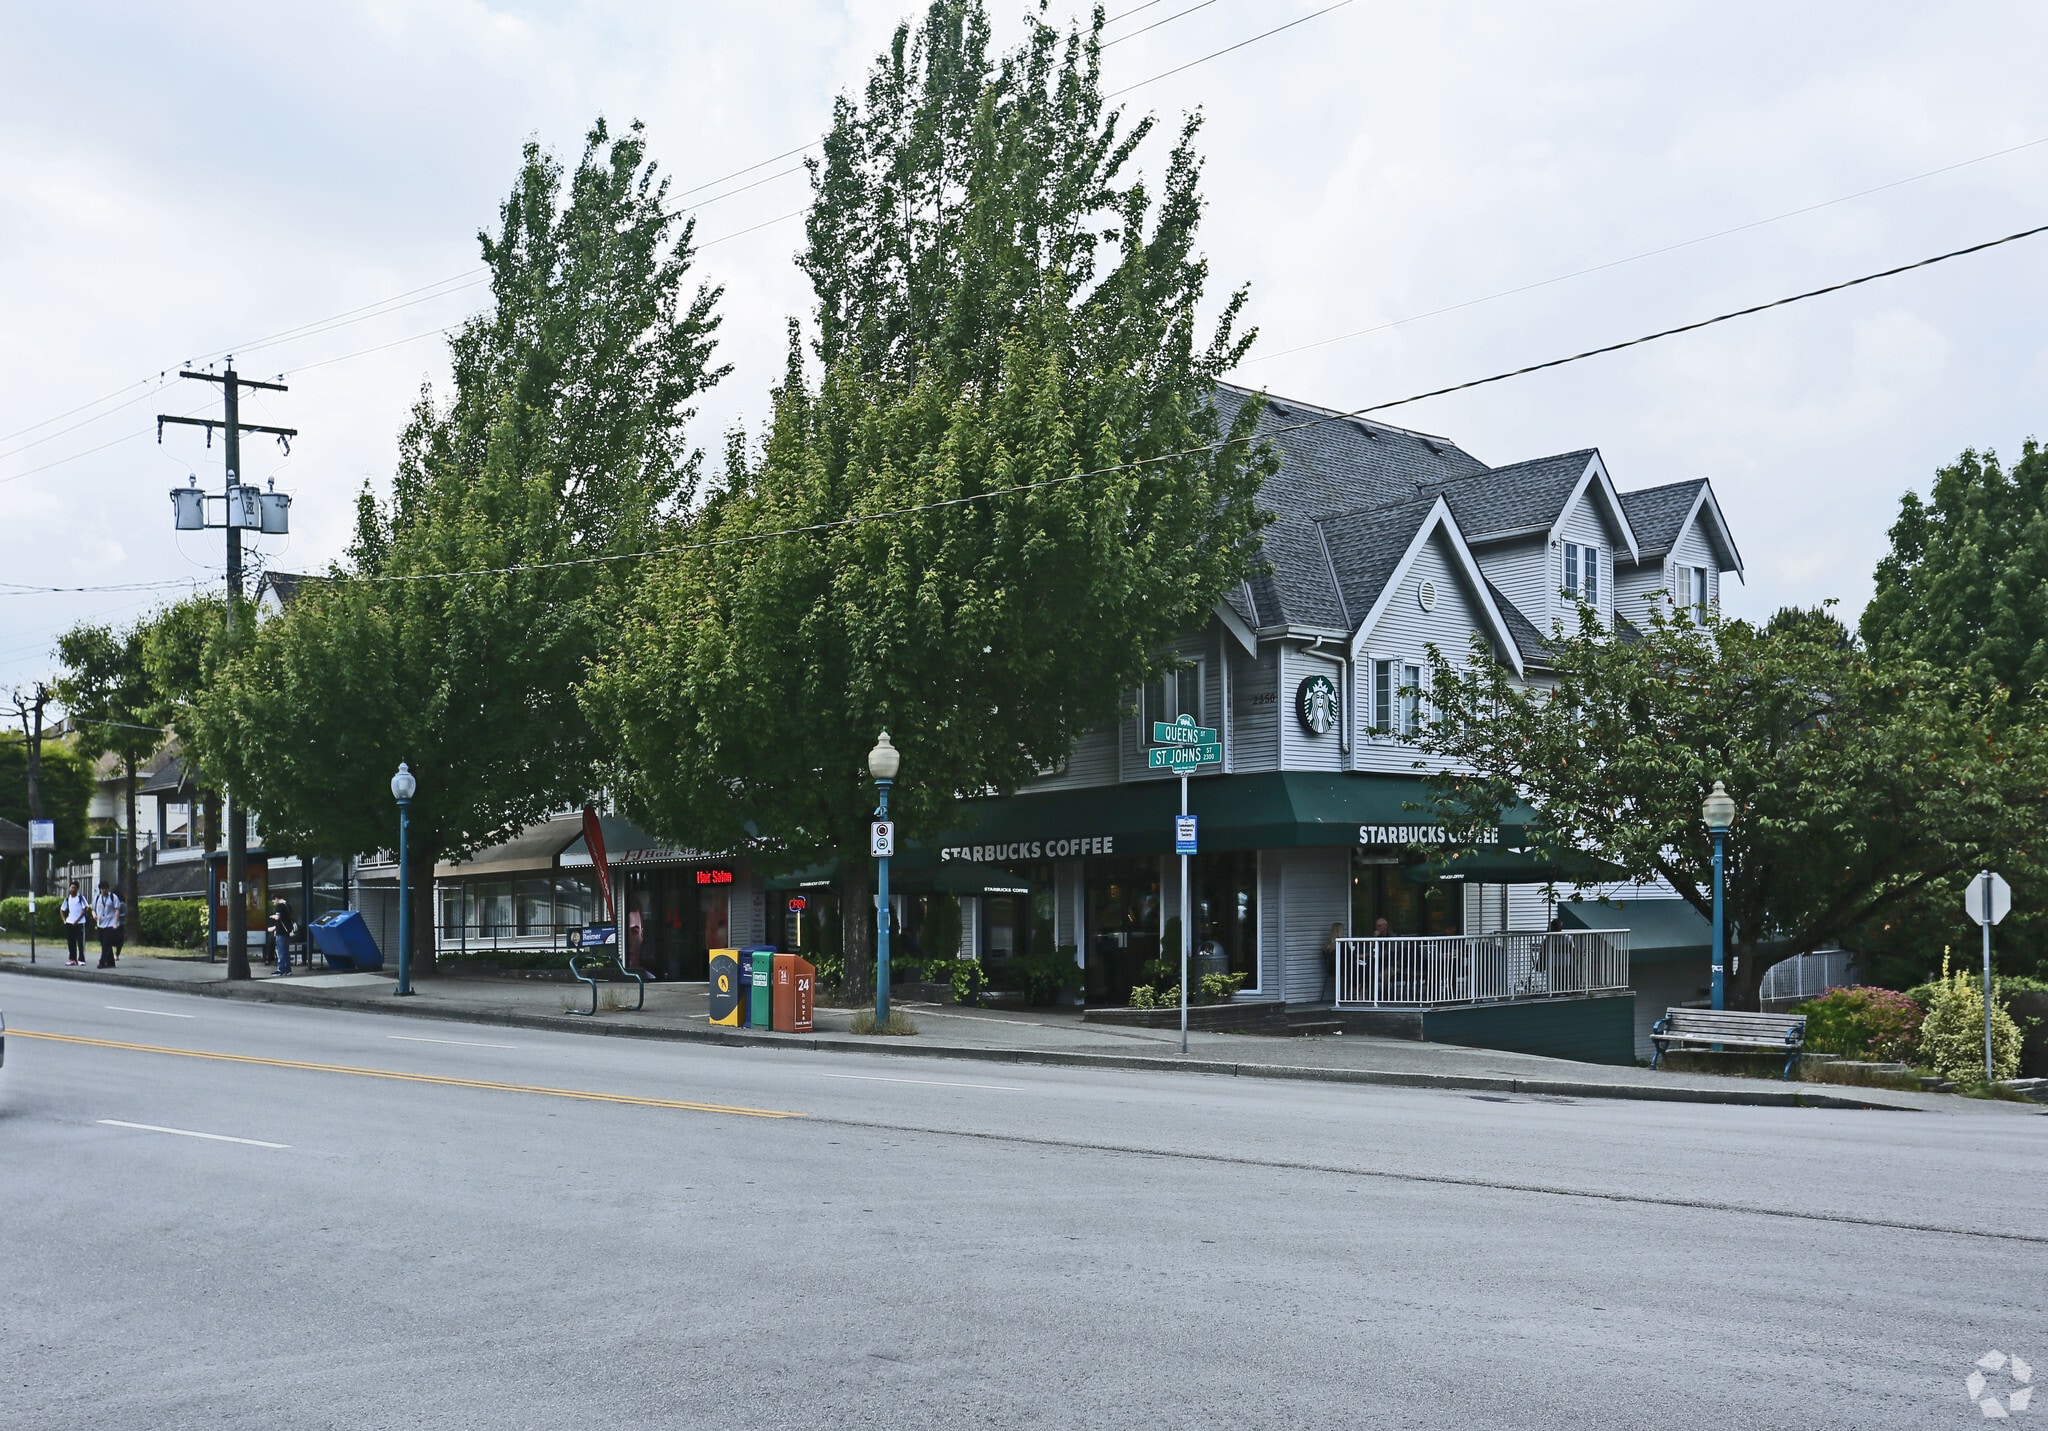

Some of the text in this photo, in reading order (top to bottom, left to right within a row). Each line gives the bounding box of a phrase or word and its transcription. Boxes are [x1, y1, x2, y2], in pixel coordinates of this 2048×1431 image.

[1165, 726, 1198, 743] QUEENS
[1155, 750, 1166, 765] ST
[1169, 747, 1201, 764] JOHNS
[1359, 825, 1446, 844] STARBUCKS
[941, 836, 1113, 862] STARBUCKS COFFEE
[696, 871, 711, 884] Hair
[789, 899, 806, 909] OPEN
[798, 979, 809, 991] 24
